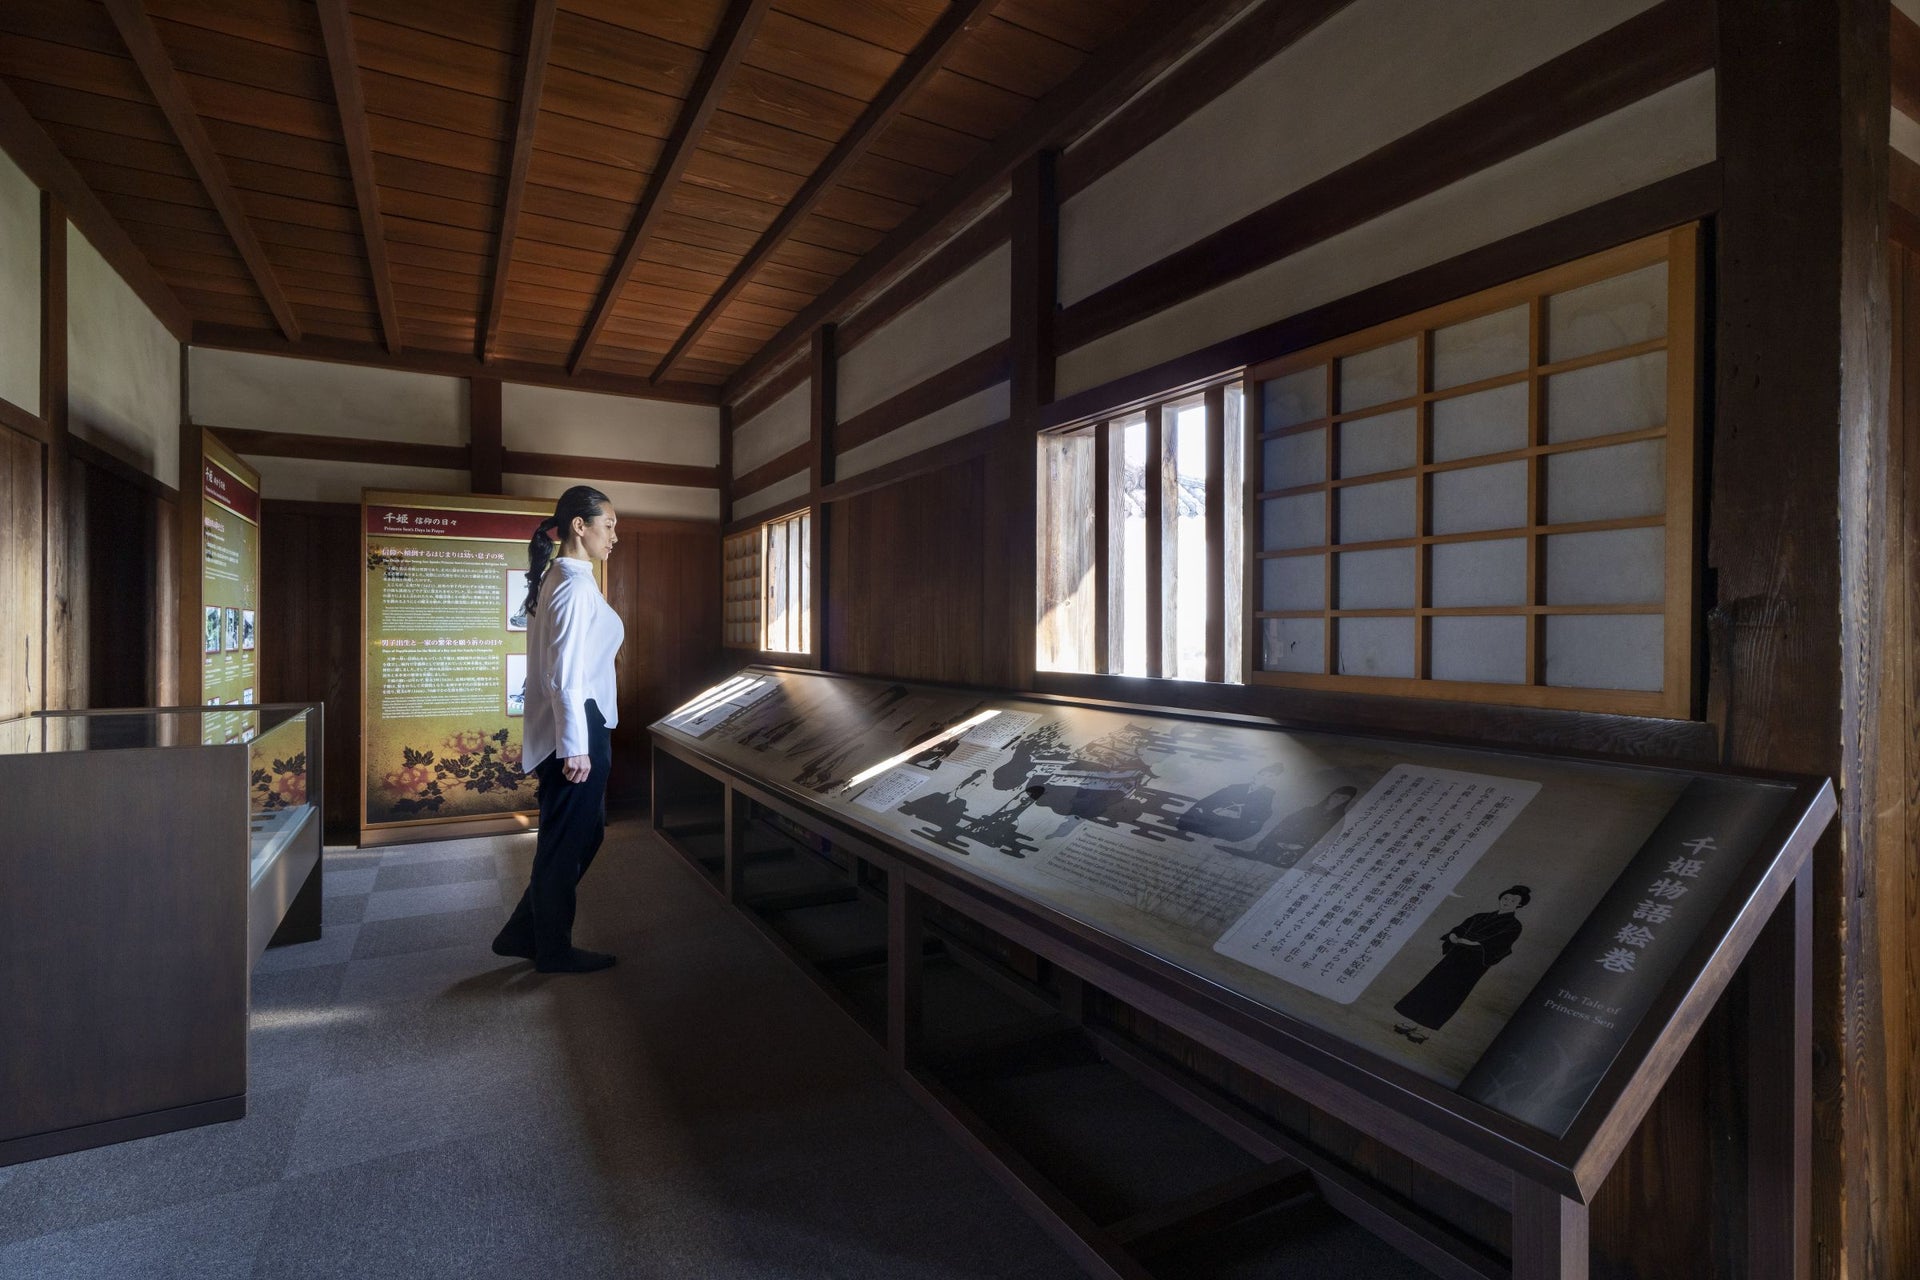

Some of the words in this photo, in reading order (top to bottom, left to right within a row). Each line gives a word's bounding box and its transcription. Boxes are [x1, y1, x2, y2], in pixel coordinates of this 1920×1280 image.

[383, 512, 409, 524] 千姫
[414, 516, 458, 527] 信仰の日々
[382, 548, 505, 560] 信仰へ傾倒するはじまりは幼い息子の死
[382, 639, 503, 647] 男子出生と一家の繁栄を願う祈りの日々
[1594, 836, 1718, 974] 千姫物語絵巻
[1557, 988, 1579, 1002] The
[1582, 994, 1603, 1009] Tale
[1606, 1006, 1623, 1016] of
[1543, 999, 1591, 1022] Princess
[1592, 1015, 1616, 1030] Sen
